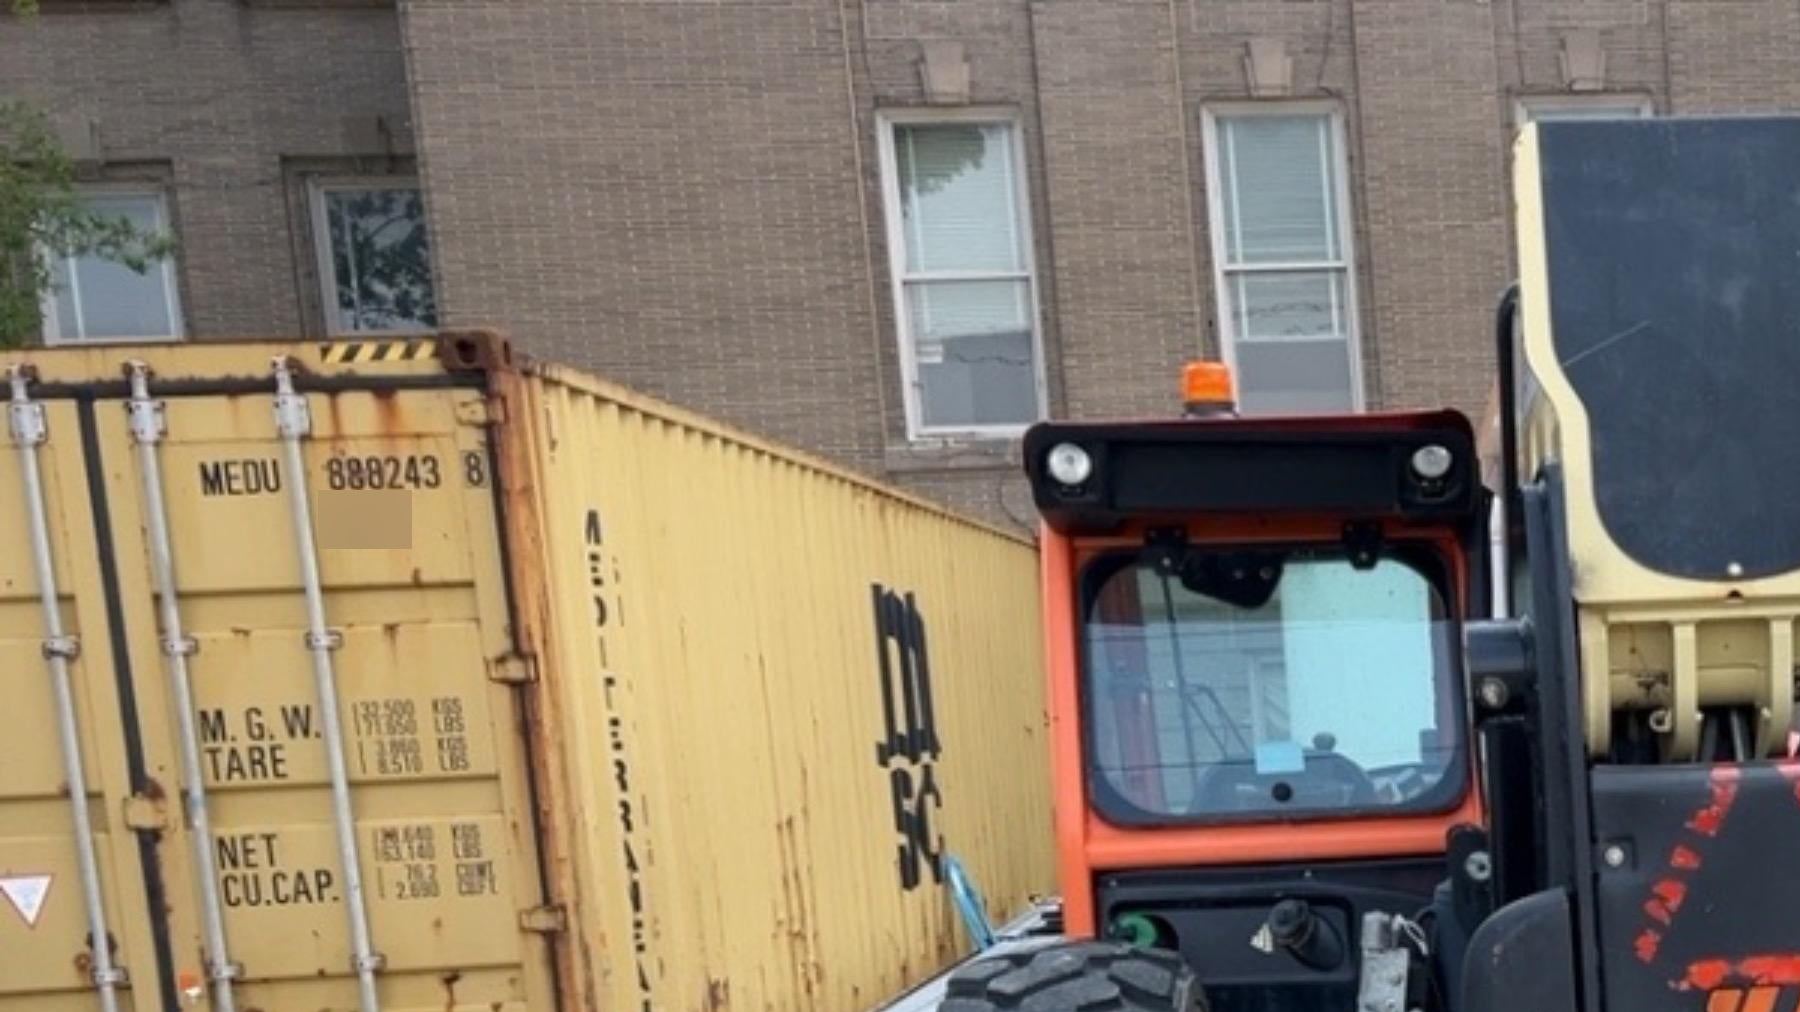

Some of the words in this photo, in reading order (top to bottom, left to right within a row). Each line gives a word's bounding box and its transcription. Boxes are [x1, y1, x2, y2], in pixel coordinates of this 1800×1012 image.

[200, 458, 281, 495] MEDU
[327, 454, 440, 490] 888243
[464, 452, 484, 487] 8
[203, 743, 289, 782] TARE
[216, 833, 278, 870] NET
[221, 868, 340, 907] CU.CAP.
